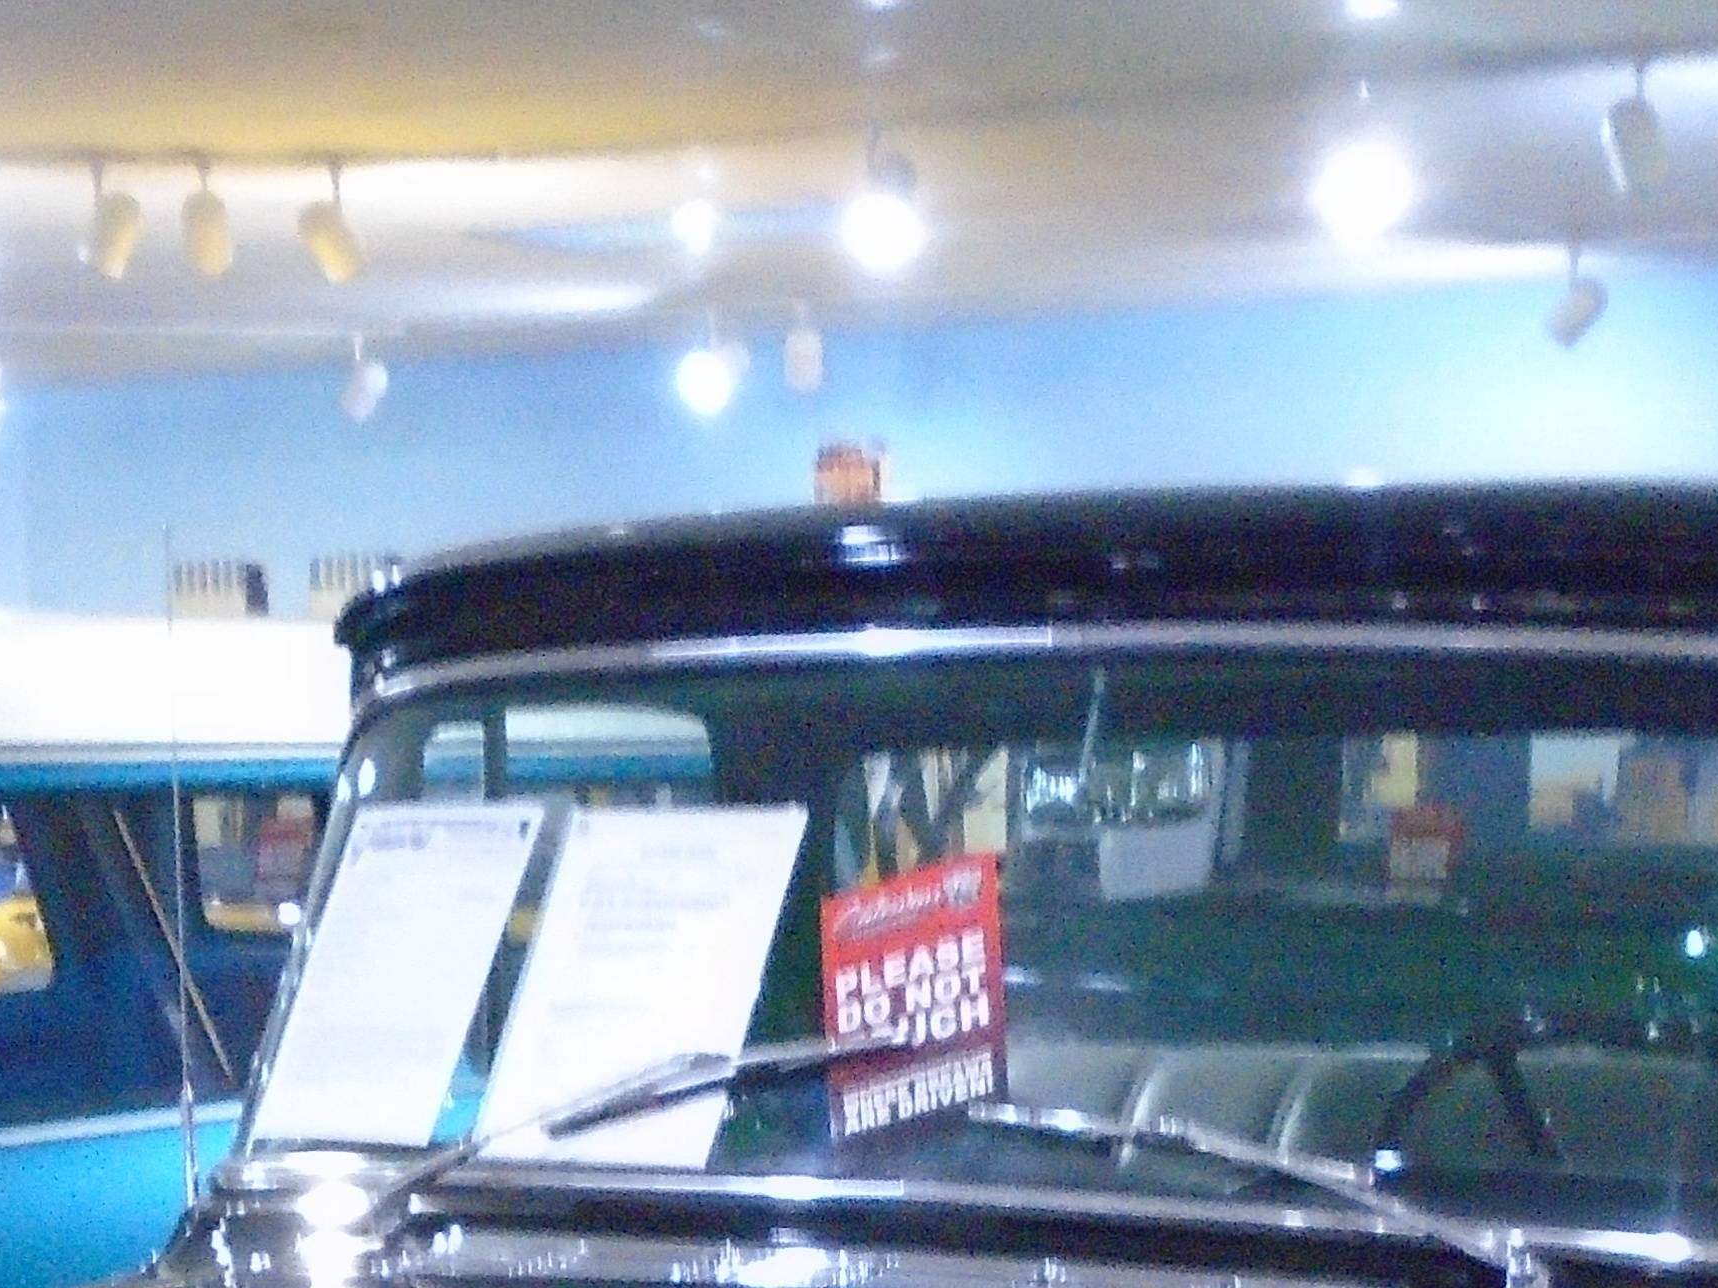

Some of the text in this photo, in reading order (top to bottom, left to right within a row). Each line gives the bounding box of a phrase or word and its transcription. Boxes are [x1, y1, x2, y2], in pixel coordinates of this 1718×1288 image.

[836, 930, 986, 1003] PLEASE
[837, 967, 982, 1034] DO NOT
